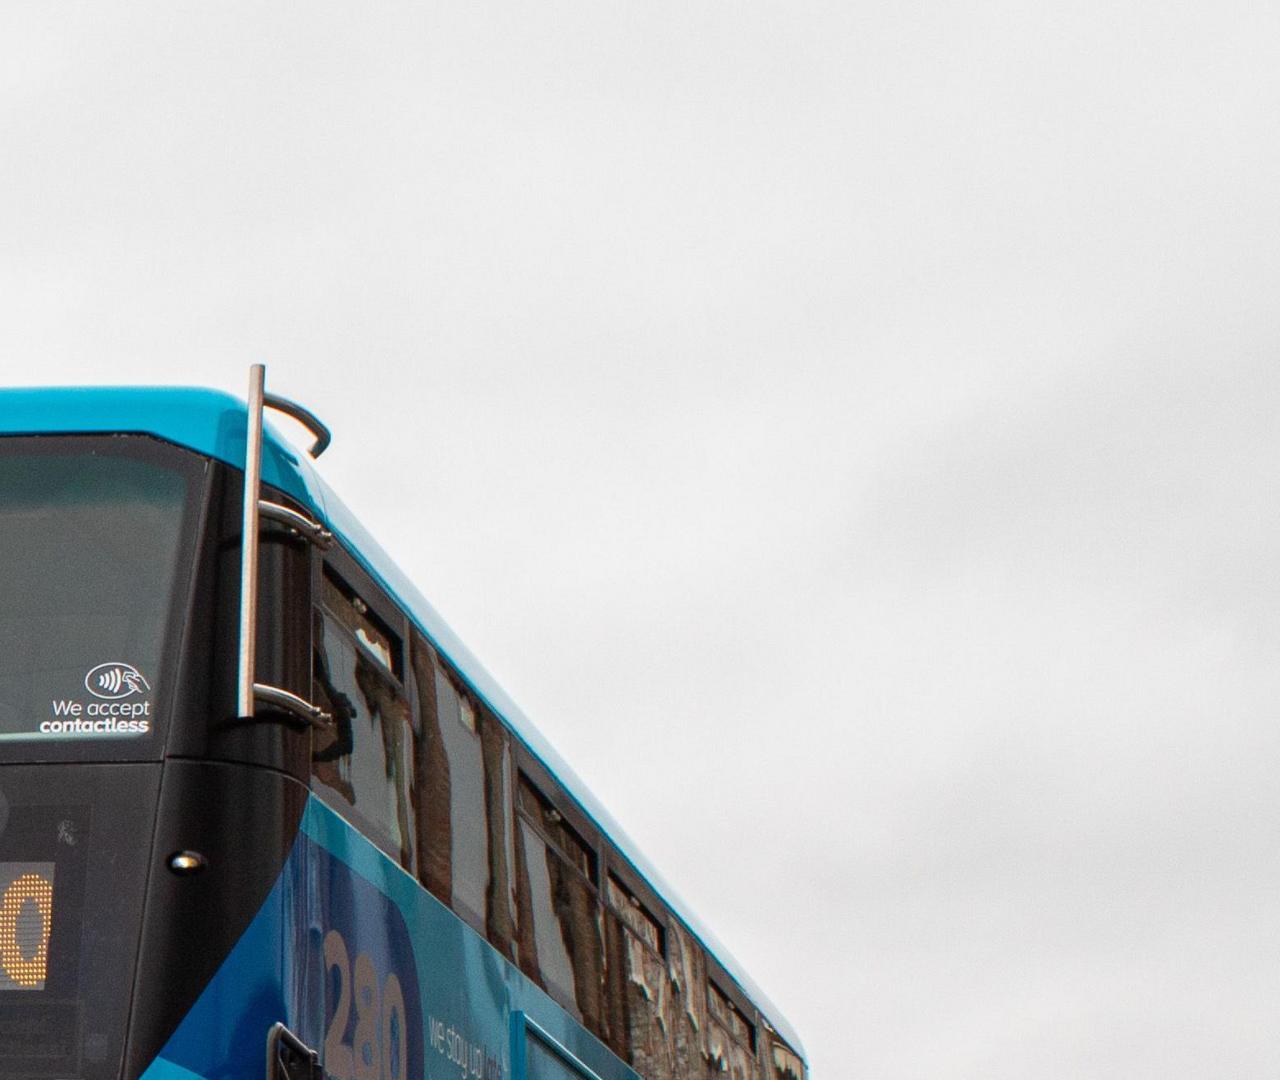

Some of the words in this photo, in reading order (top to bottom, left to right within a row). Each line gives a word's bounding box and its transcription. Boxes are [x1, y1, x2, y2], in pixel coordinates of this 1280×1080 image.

[52, 700, 82, 716] We
[87, 700, 150, 720] accept
[40, 718, 150, 734] contactless
